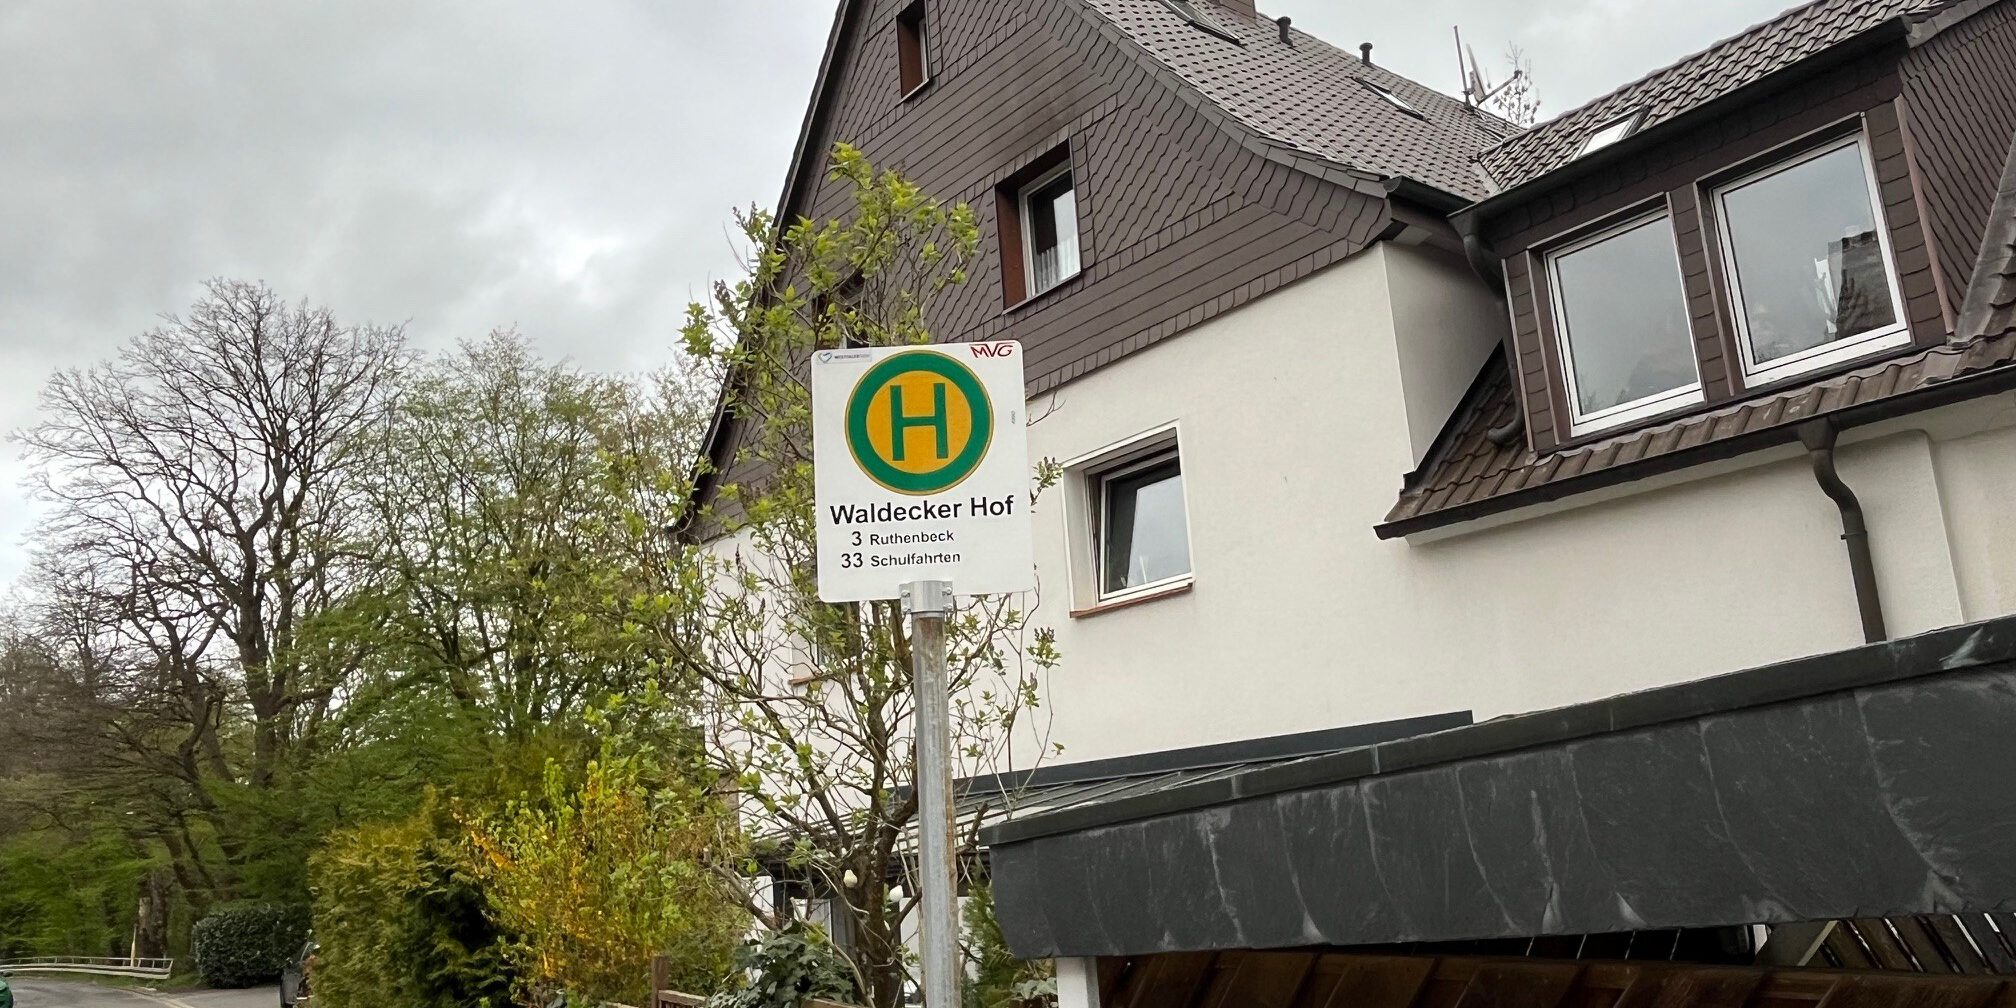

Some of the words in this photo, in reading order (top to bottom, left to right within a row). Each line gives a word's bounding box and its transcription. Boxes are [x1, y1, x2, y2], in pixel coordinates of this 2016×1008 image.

[970, 342, 1015, 359] MVG
[890, 383, 949, 461] H
[830, 500, 963, 525] Waldecker
[970, 495, 1014, 517] Hof
[851, 531, 863, 547] 3
[869, 530, 955, 546] Ruthenbeck
[841, 552, 864, 568] 33
[870, 552, 961, 567] Schulfahrten
